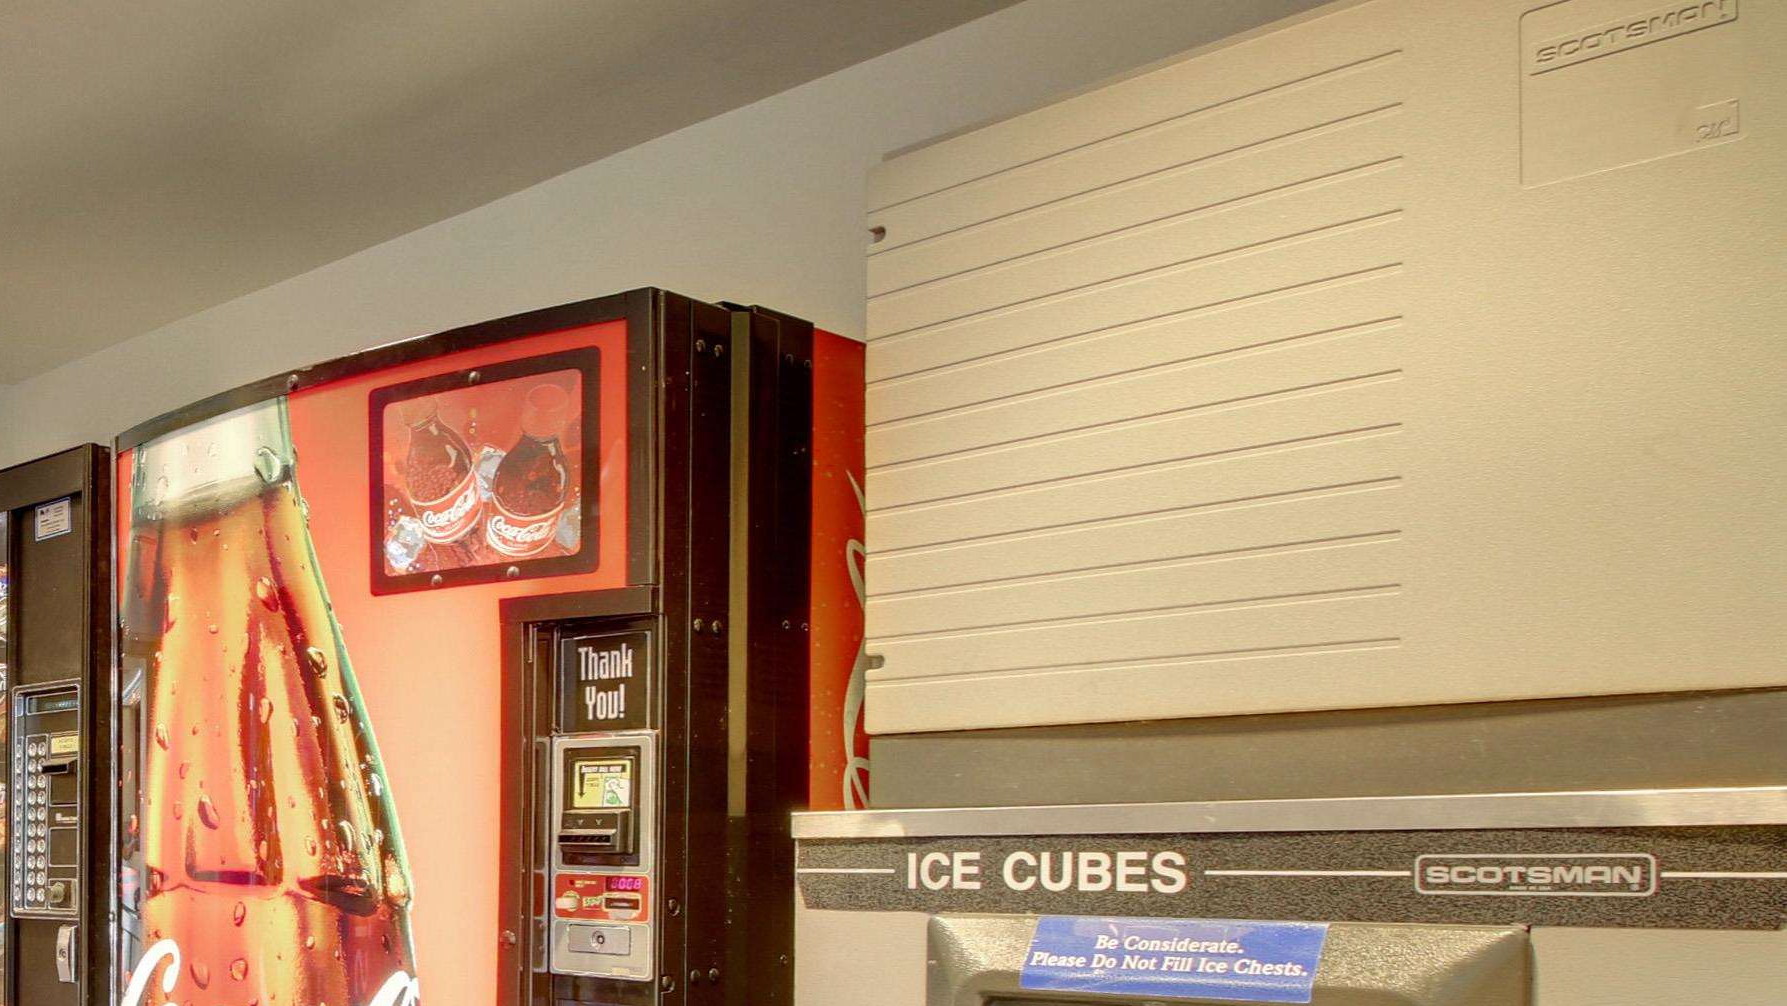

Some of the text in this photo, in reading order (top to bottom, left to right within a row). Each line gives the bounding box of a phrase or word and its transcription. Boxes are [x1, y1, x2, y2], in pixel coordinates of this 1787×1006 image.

[1535, 0, 1725, 63] SCOTSMAN
[423, 481, 475, 527] Coca-Cola
[487, 515, 557, 543] Coca-Cola
[577, 643, 633, 681] Thank
[585, 684, 625, 720] You!
[907, 850, 1188, 893] ICE CUBES
[1425, 865, 1641, 884] SCOTSMAN
[1094, 934, 1245, 954] Be Considerate.
[1030, 951, 1309, 977] Please Do Not Fill Ice Chests.
